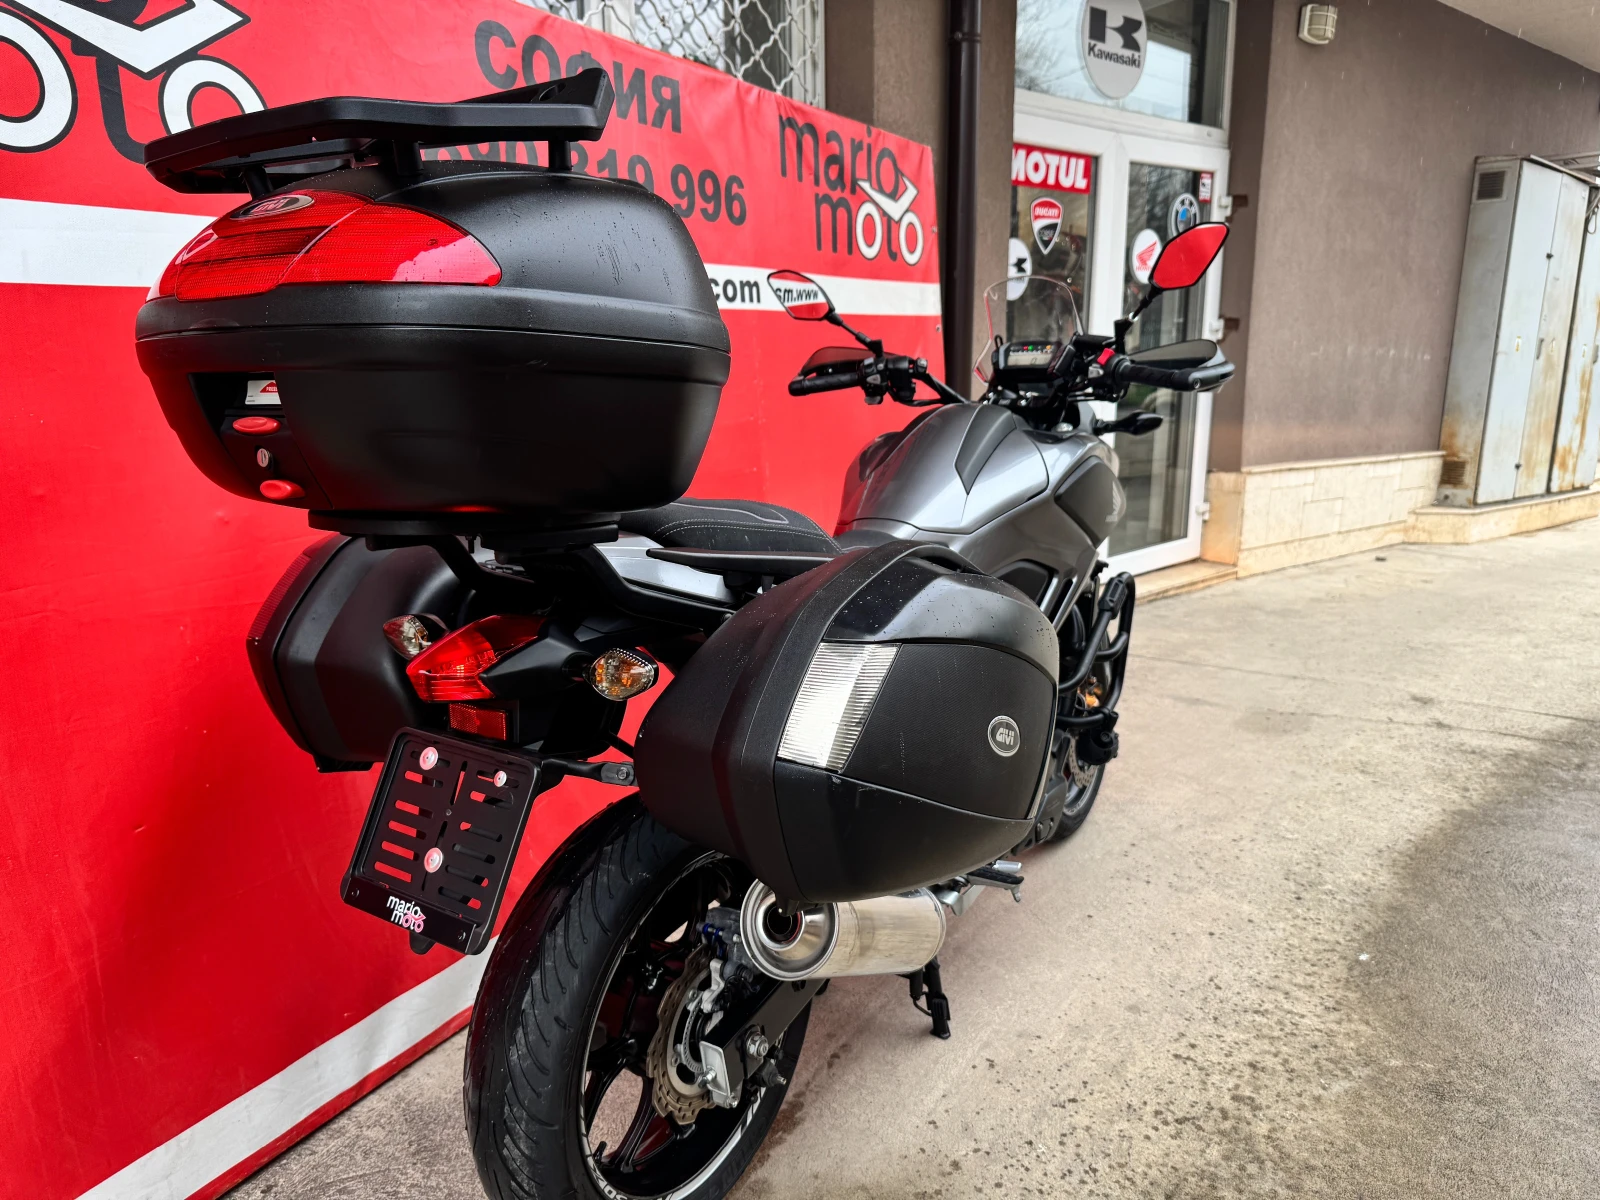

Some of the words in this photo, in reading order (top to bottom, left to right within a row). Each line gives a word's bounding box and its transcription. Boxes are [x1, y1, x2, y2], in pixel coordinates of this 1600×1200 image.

[1088, 42, 1140, 68] Kawasaki
[779, 114, 900, 195] mario
[1011, 147, 1088, 190] MOTUL
[671, 163, 747, 226] 996
[815, 192, 924, 266] moto
[386, 895, 420, 918] mario
[391, 910, 424, 933] moto
